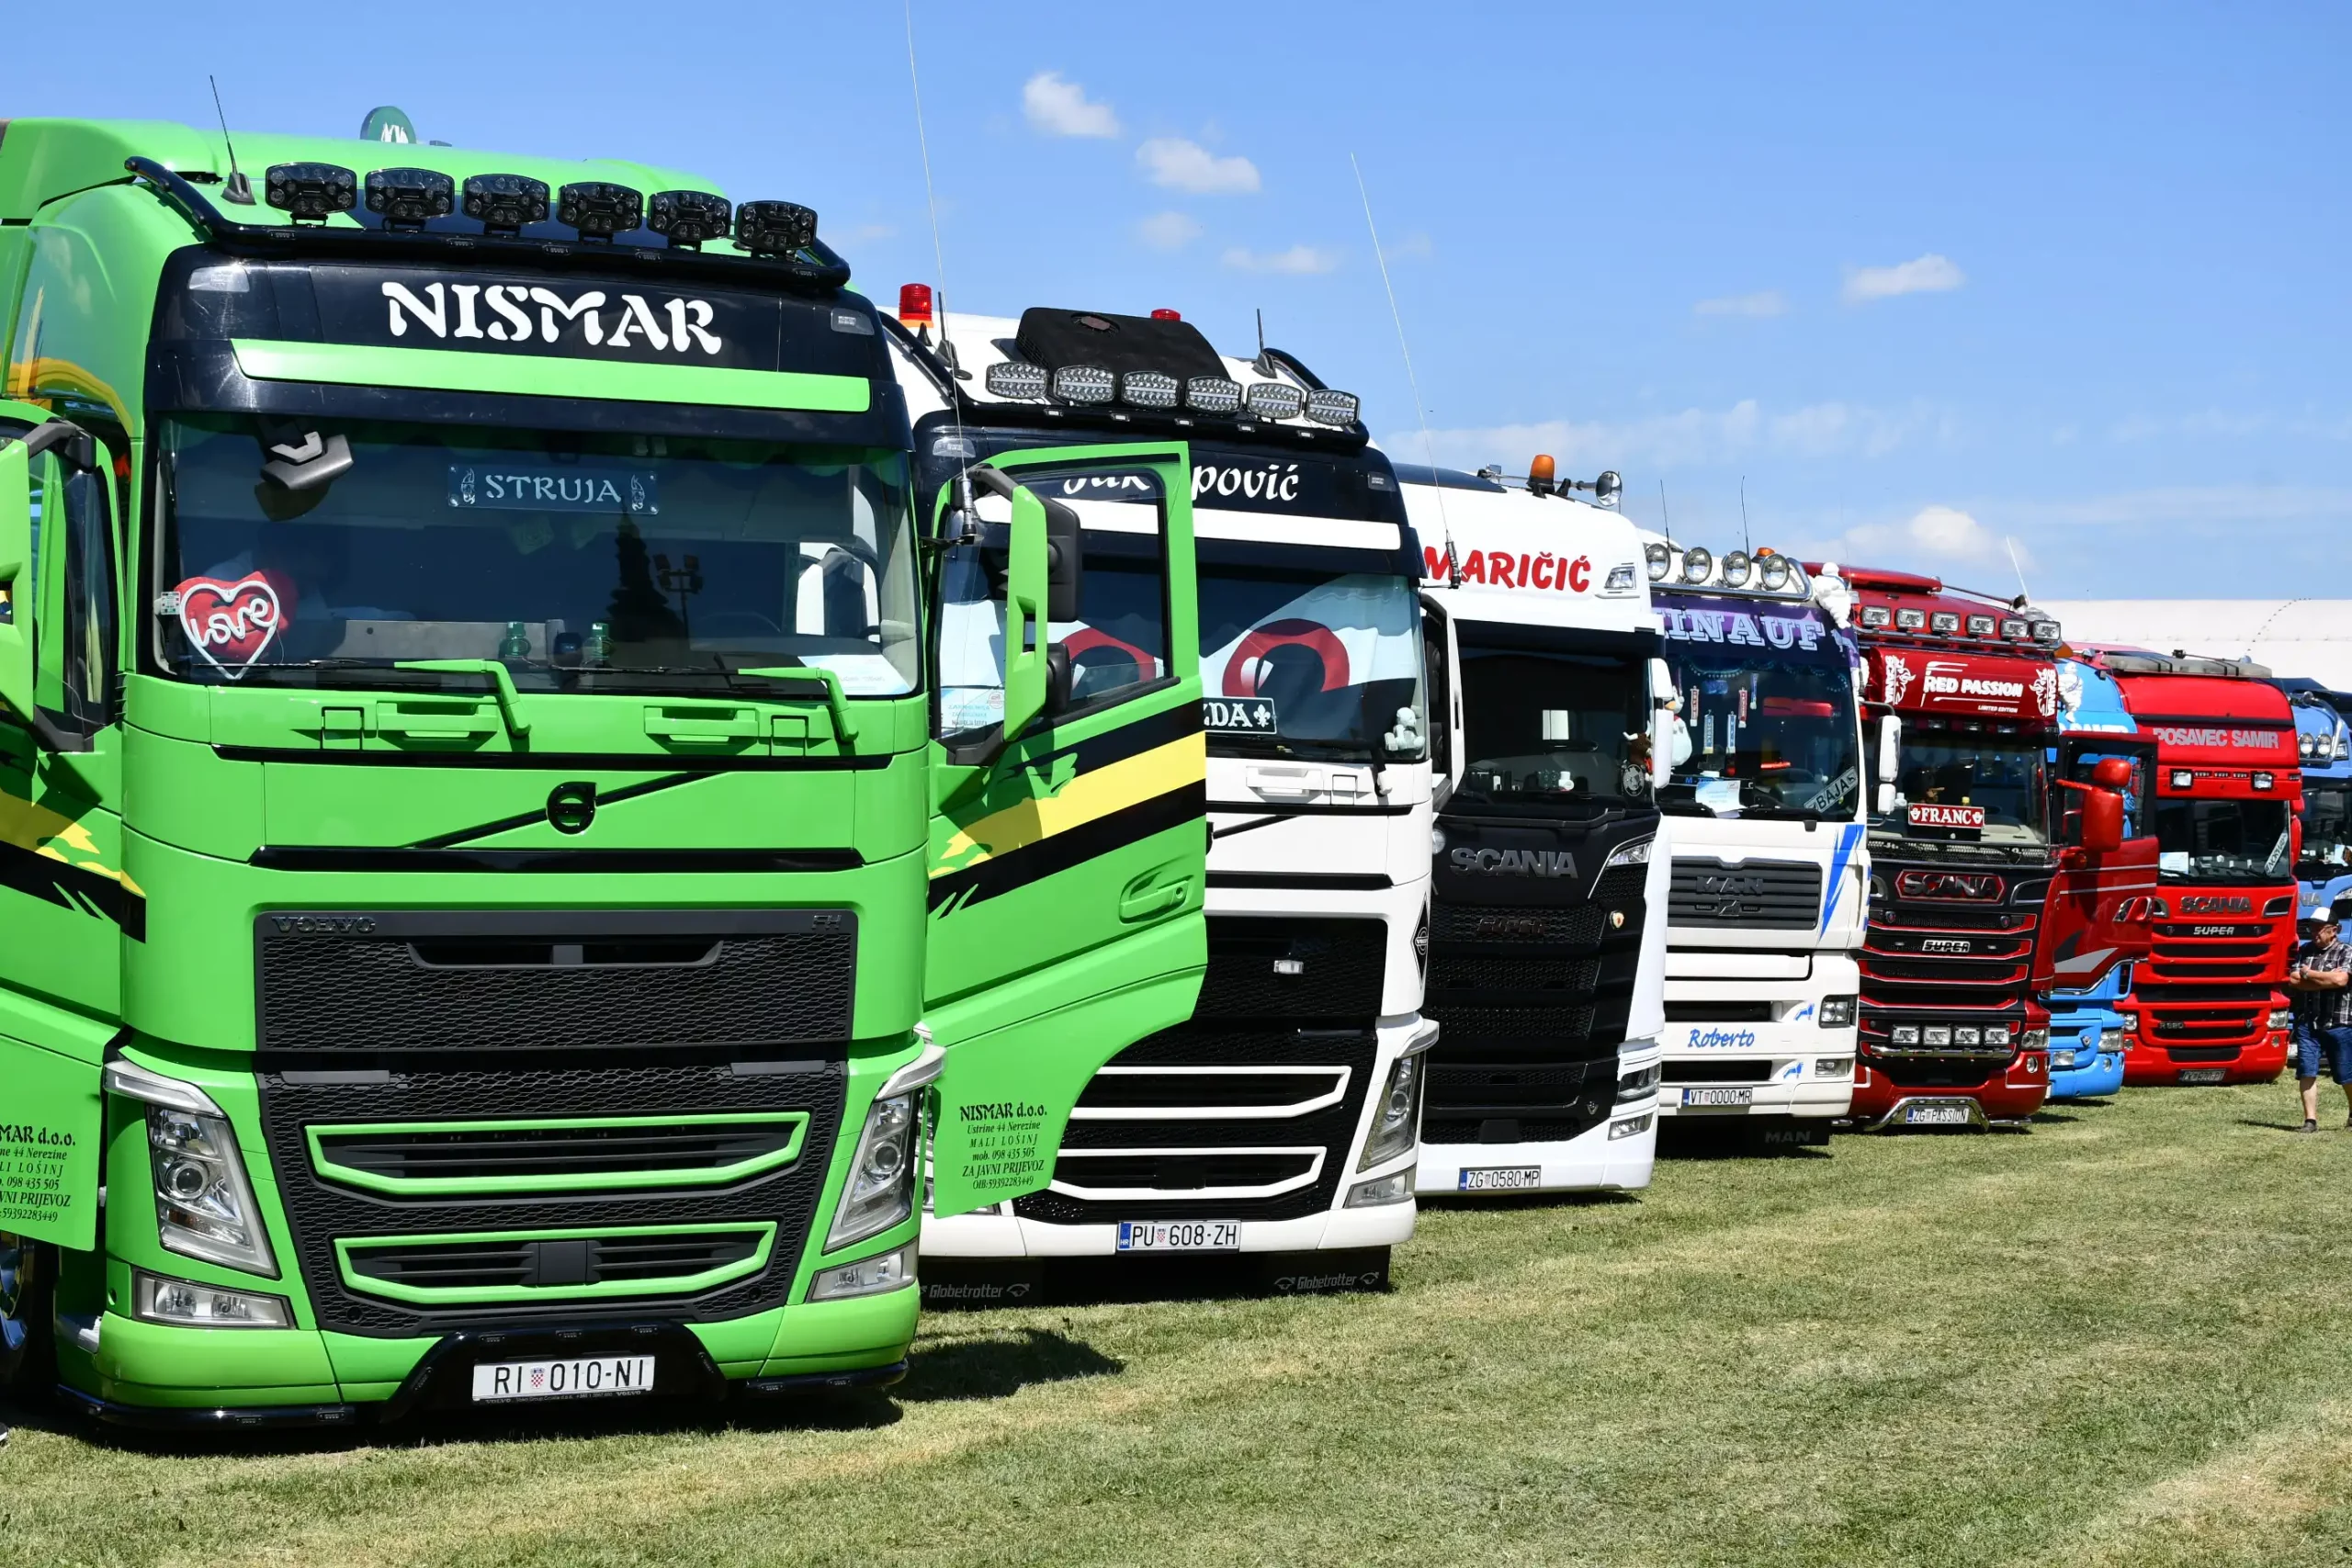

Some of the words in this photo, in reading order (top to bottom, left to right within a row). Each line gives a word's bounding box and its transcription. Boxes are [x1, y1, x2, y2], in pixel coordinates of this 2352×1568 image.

[381, 281, 722, 355] NISMAR
[485, 474, 622, 503] STRUJA
[1424, 546, 1591, 592] MARIČIĆ
[1923, 676, 1959, 694] RED
[1961, 679, 2024, 698] PASSION
[2154, 728, 2228, 747] POSAVEC
[2232, 729, 2279, 749] SAMIR
[1816, 779, 1849, 810] BAJA
[1920, 807, 1972, 825] FRANC
[1450, 847, 1578, 879] SCANIA
[1696, 876, 1764, 896] MAN
[2180, 897, 2253, 914] SCANIA
[271, 916, 376, 934] VOLVO
[2193, 926, 2235, 936] SUPER
[1922, 940, 1971, 953] SUPER
[1688, 1028, 1755, 1048] Roberto
[1691, 1090, 1704, 1104] VT
[959, 1102, 1013, 1122] NISMAR
[1016, 1101, 1047, 1118] d.o.o.
[1914, 1109, 1926, 1122] ZG
[1932, 1109, 1966, 1122] PASSION
[0, 1123, 34, 1145] MAR
[38, 1127, 76, 1146] d.o.o.
[967, 1123, 995, 1134] Ustrine
[997, 1122, 1006, 1133] 44
[1007, 1120, 1041, 1132] Nerezine
[969, 1137, 995, 1148] MALI
[1001, 1133, 1038, 1146] LOŠINJ
[1764, 1131, 1811, 1144] MAN
[14, 1146, 24, 1157] 44
[26, 1147, 68, 1160] Nerezine
[992, 1149, 1006, 1161] 098
[1007, 1147, 1021, 1159] 435
[1022, 1146, 1035, 1158] 505
[18, 1160, 63, 1178] LOŠINJ
[962, 1165, 975, 1178] ZA
[975, 1163, 1001, 1179] JAVNI
[1002, 1159, 1045, 1176] PRIJEVOZ
[6, 1176, 24, 1188] 098
[26, 1178, 41, 1190] 435
[44, 1179, 60, 1190] 505
[1468, 1171, 1484, 1188] ZG
[1491, 1170, 1539, 1188] 0580-MP
[19, 1191, 71, 1209] PRIJEVOZ
[1119, 1238, 1130, 1247] HR
[1132, 1225, 1156, 1247] PU
[1170, 1224, 1238, 1247] 608-ZH
[1296, 1272, 1358, 1290] Globetrotter
[929, 1283, 1003, 1298] Globetrotter
[494, 1366, 523, 1394] RI
[550, 1359, 644, 1392] 010-NI
